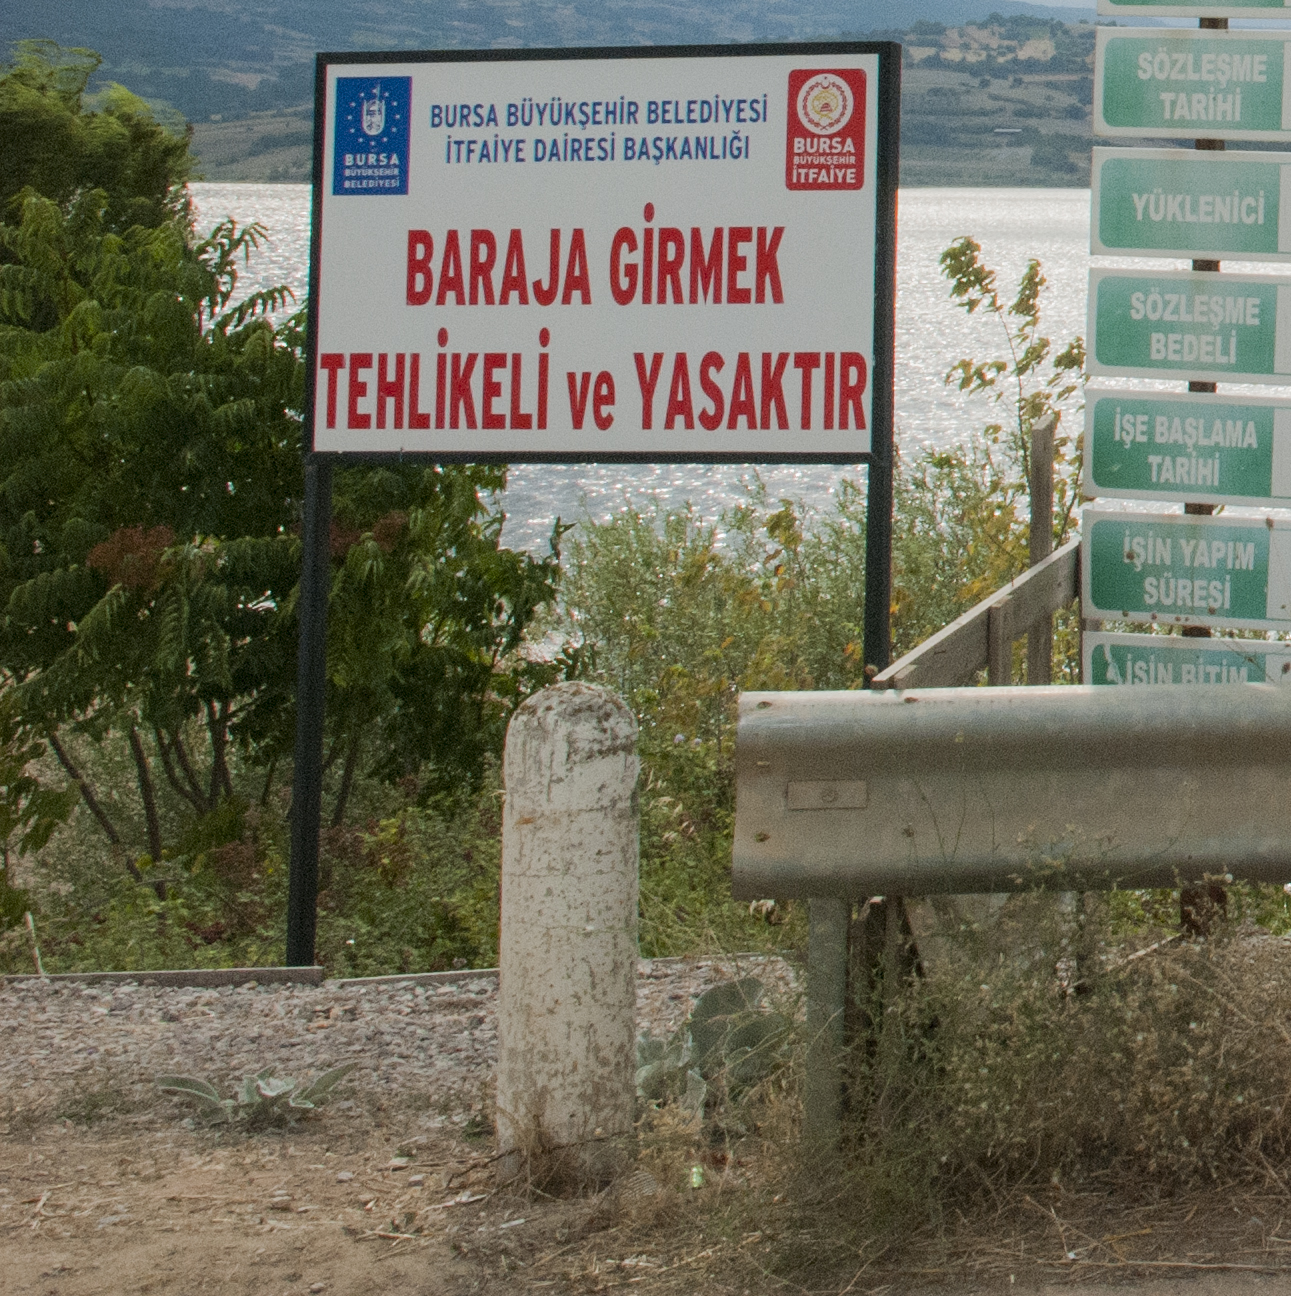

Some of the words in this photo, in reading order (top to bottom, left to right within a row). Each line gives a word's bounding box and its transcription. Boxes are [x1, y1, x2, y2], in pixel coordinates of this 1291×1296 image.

[1138, 47, 1267, 87] SÖZLEŞME
[429, 103, 499, 128] BURSA
[506, 95, 639, 130] BÜYÜKŞEHİR
[647, 93, 768, 124] BELEDİYESİ
[1160, 84, 1242, 122] TARİHİ
[344, 153, 400, 166] BURSA
[445, 133, 526, 164] İTFAİYE
[533, 132, 616, 162] DAİRESİ
[624, 129, 750, 165] BAŞKANLIĞI
[792, 137, 855, 153] BURSA
[793, 152, 856, 165] BÜYÜKŞEHİR
[792, 165, 857, 183] İTFAİYE
[1133, 186, 1265, 226] YÜKLENİCİ
[406, 227, 592, 306] BARAJA
[610, 202, 785, 305] GİRMEK
[1130, 287, 1261, 329] SÖZLEŞME
[1150, 330, 1236, 364] BEDELİ
[320, 327, 551, 430] TEHLİKELİ
[567, 368, 615, 430] ve
[633, 351, 867, 430] YASAKTIR
[1114, 406, 1148, 446] İŞE
[1155, 417, 1258, 452] BAŞLAMA
[1148, 450, 1220, 487] TARİHİ
[1123, 529, 1171, 572] İŞİN
[1178, 539, 1254, 570] YAPIM
[1143, 569, 1231, 609] SÜRESİ
